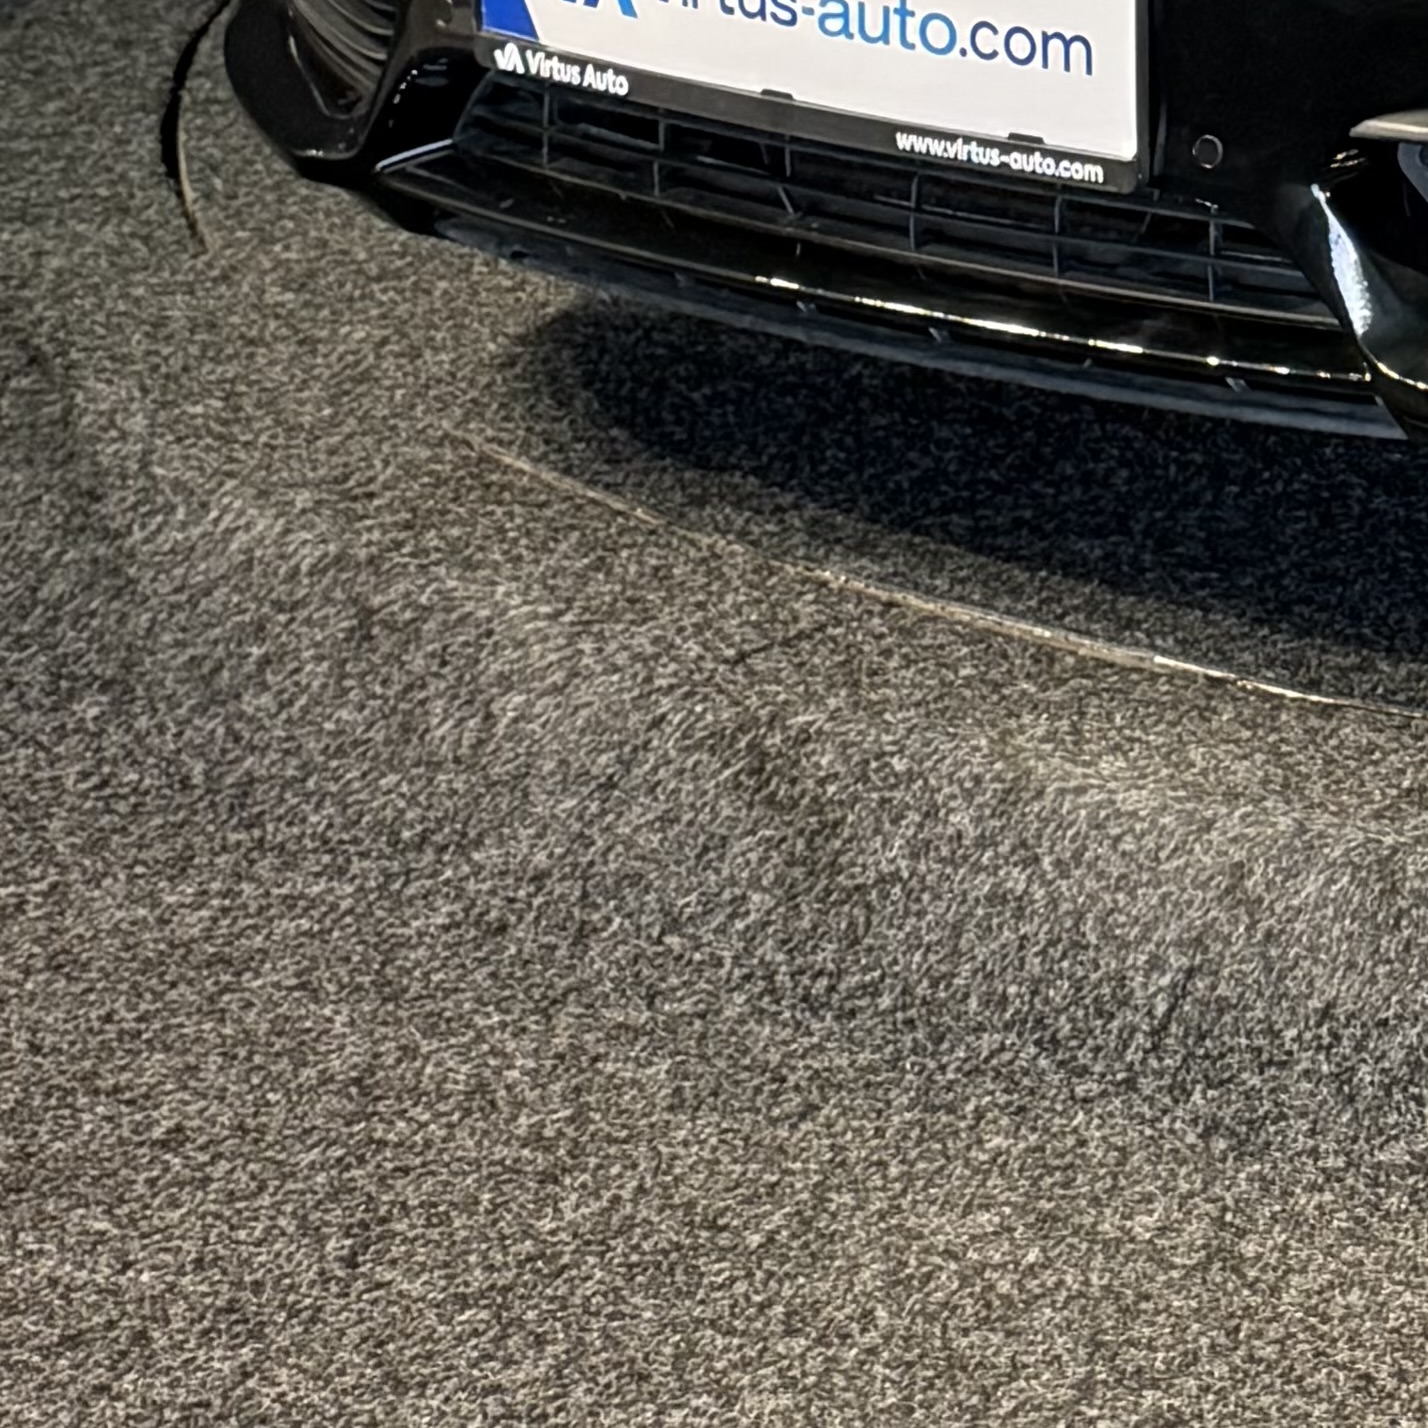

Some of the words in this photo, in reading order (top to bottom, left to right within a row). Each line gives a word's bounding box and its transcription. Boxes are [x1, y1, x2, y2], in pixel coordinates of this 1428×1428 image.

[525, 49, 582, 86] Virtus
[582, 63, 630, 97] Auto
[895, 131, 1105, 184] www.virtus-auto.com
